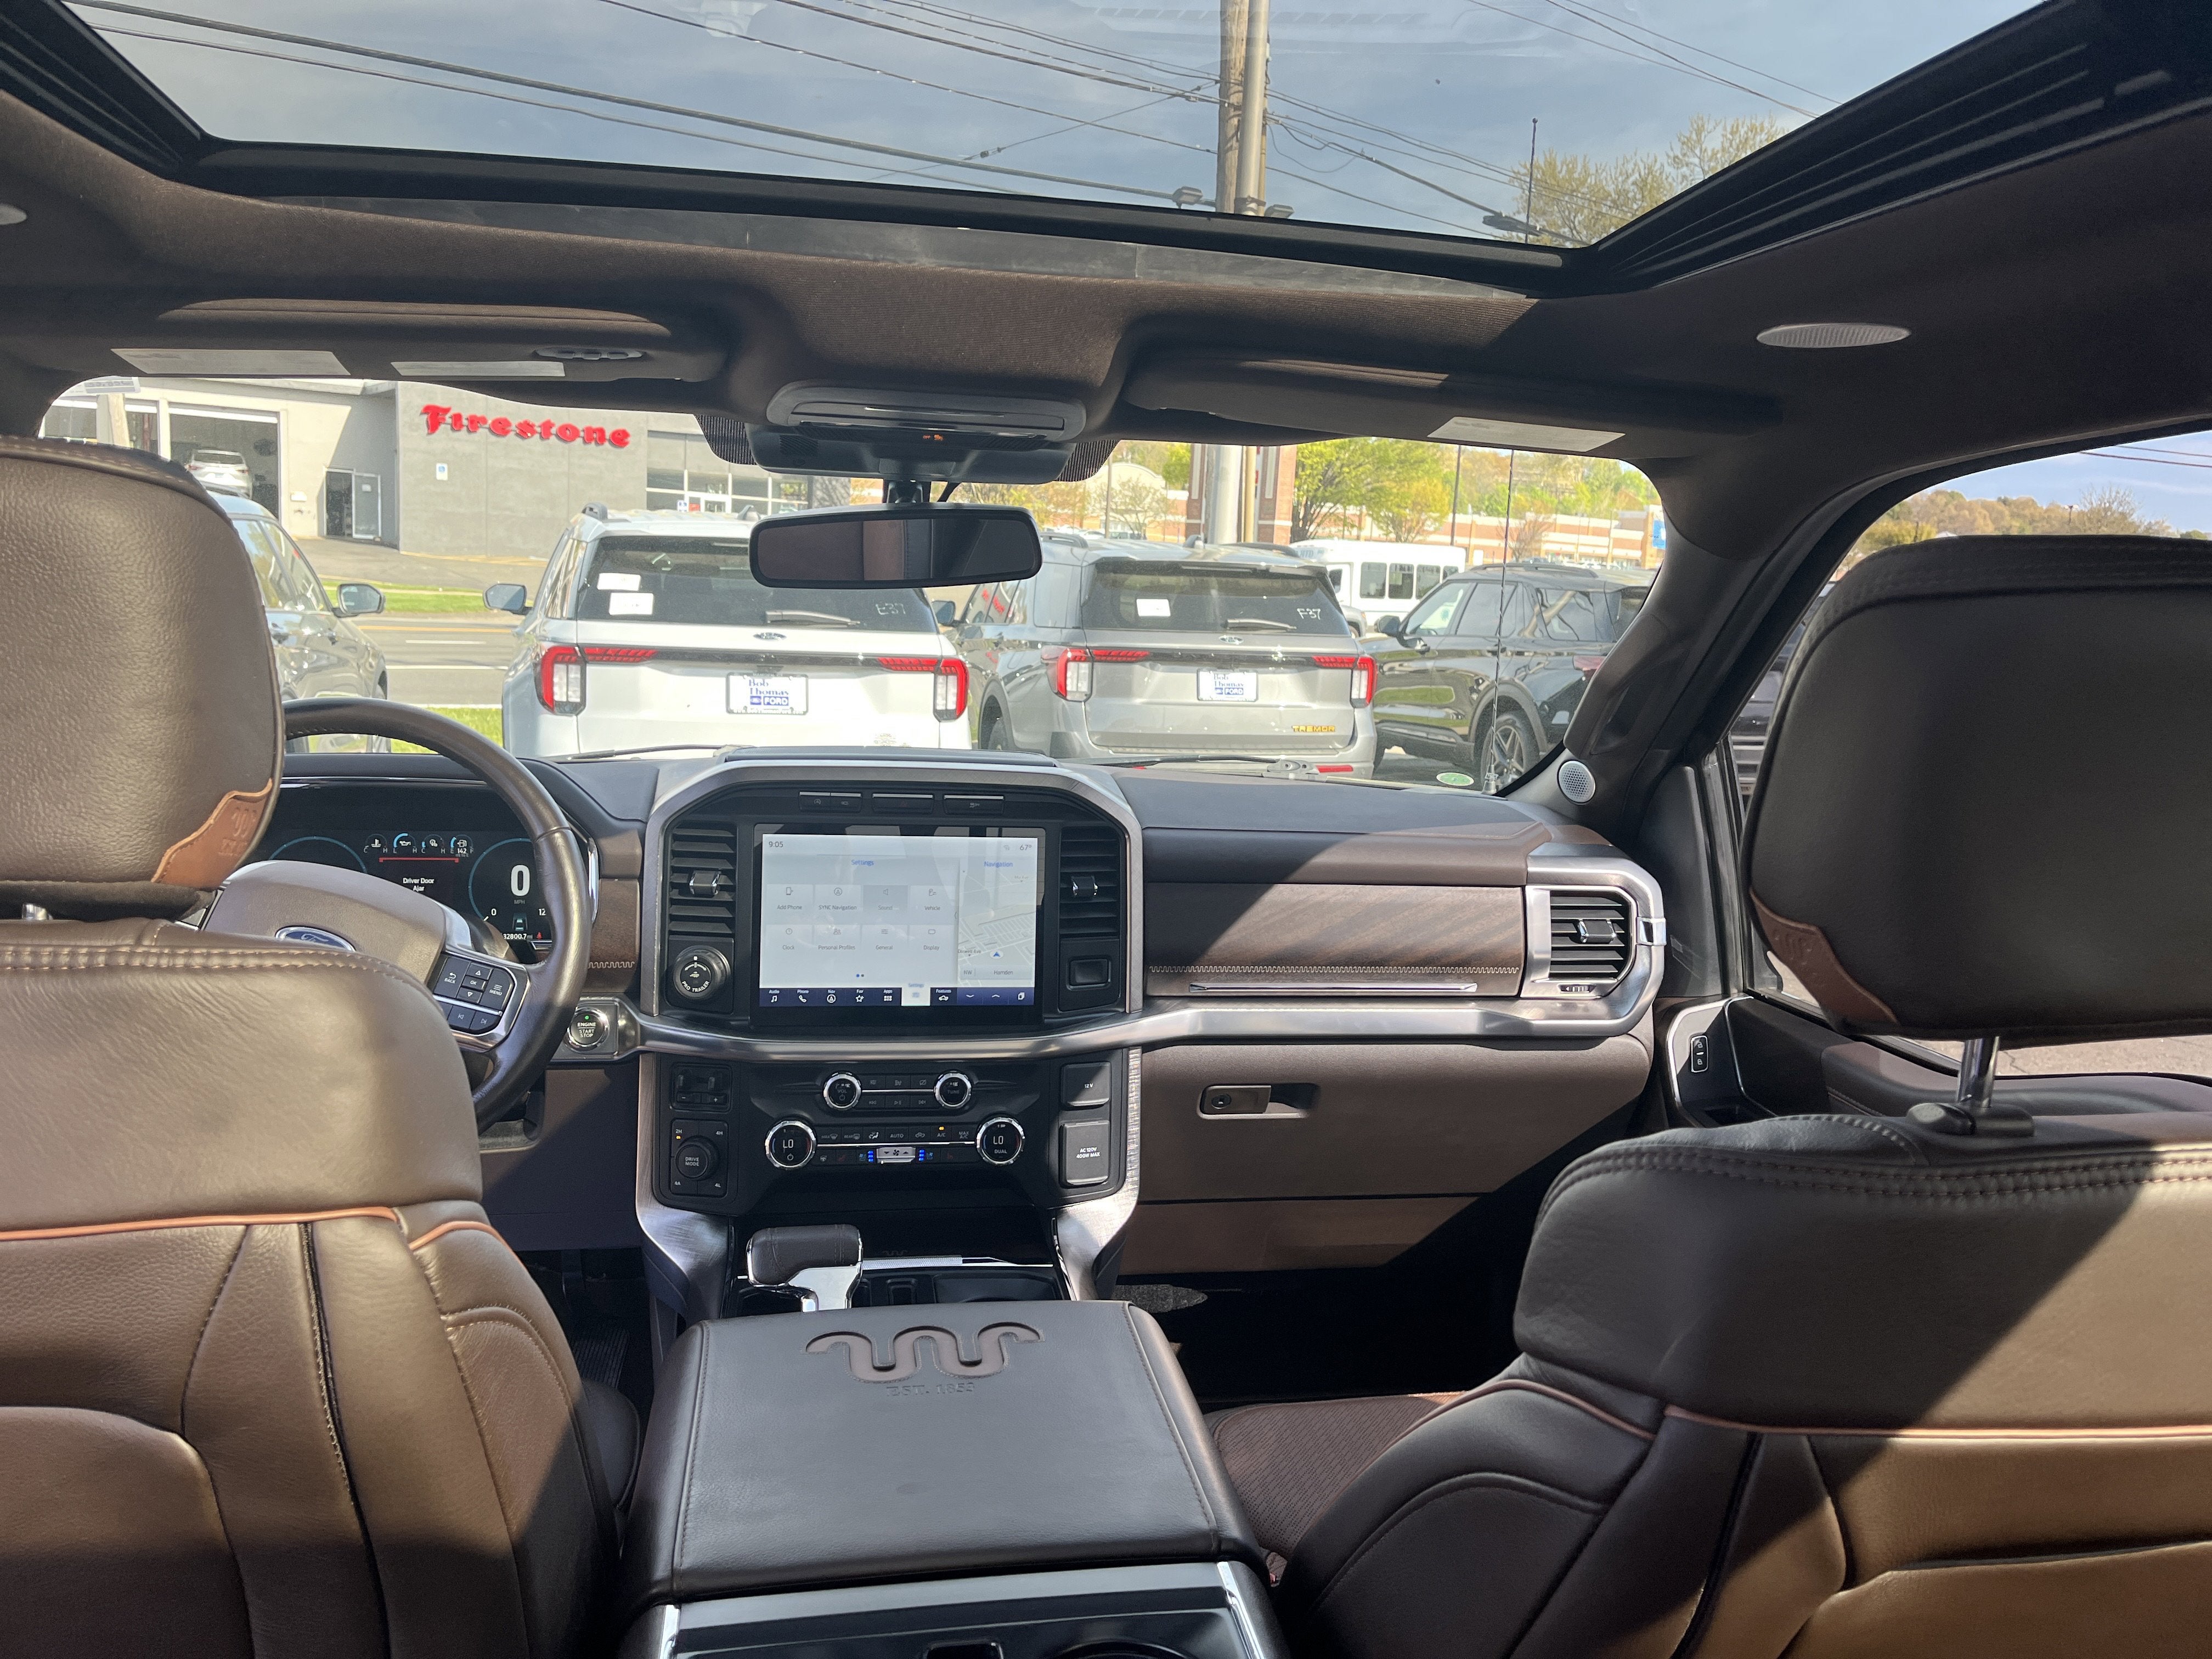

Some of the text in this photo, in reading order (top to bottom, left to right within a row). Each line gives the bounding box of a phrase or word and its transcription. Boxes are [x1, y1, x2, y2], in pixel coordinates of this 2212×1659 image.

[421, 404, 630, 447] Firestone
[876, 603, 906, 615] E37
[1297, 608, 1321, 620] F37
[764, 697, 788, 706] FORD
[511, 865, 530, 896] 0
[682, 980, 710, 992] PRO TRAILER
